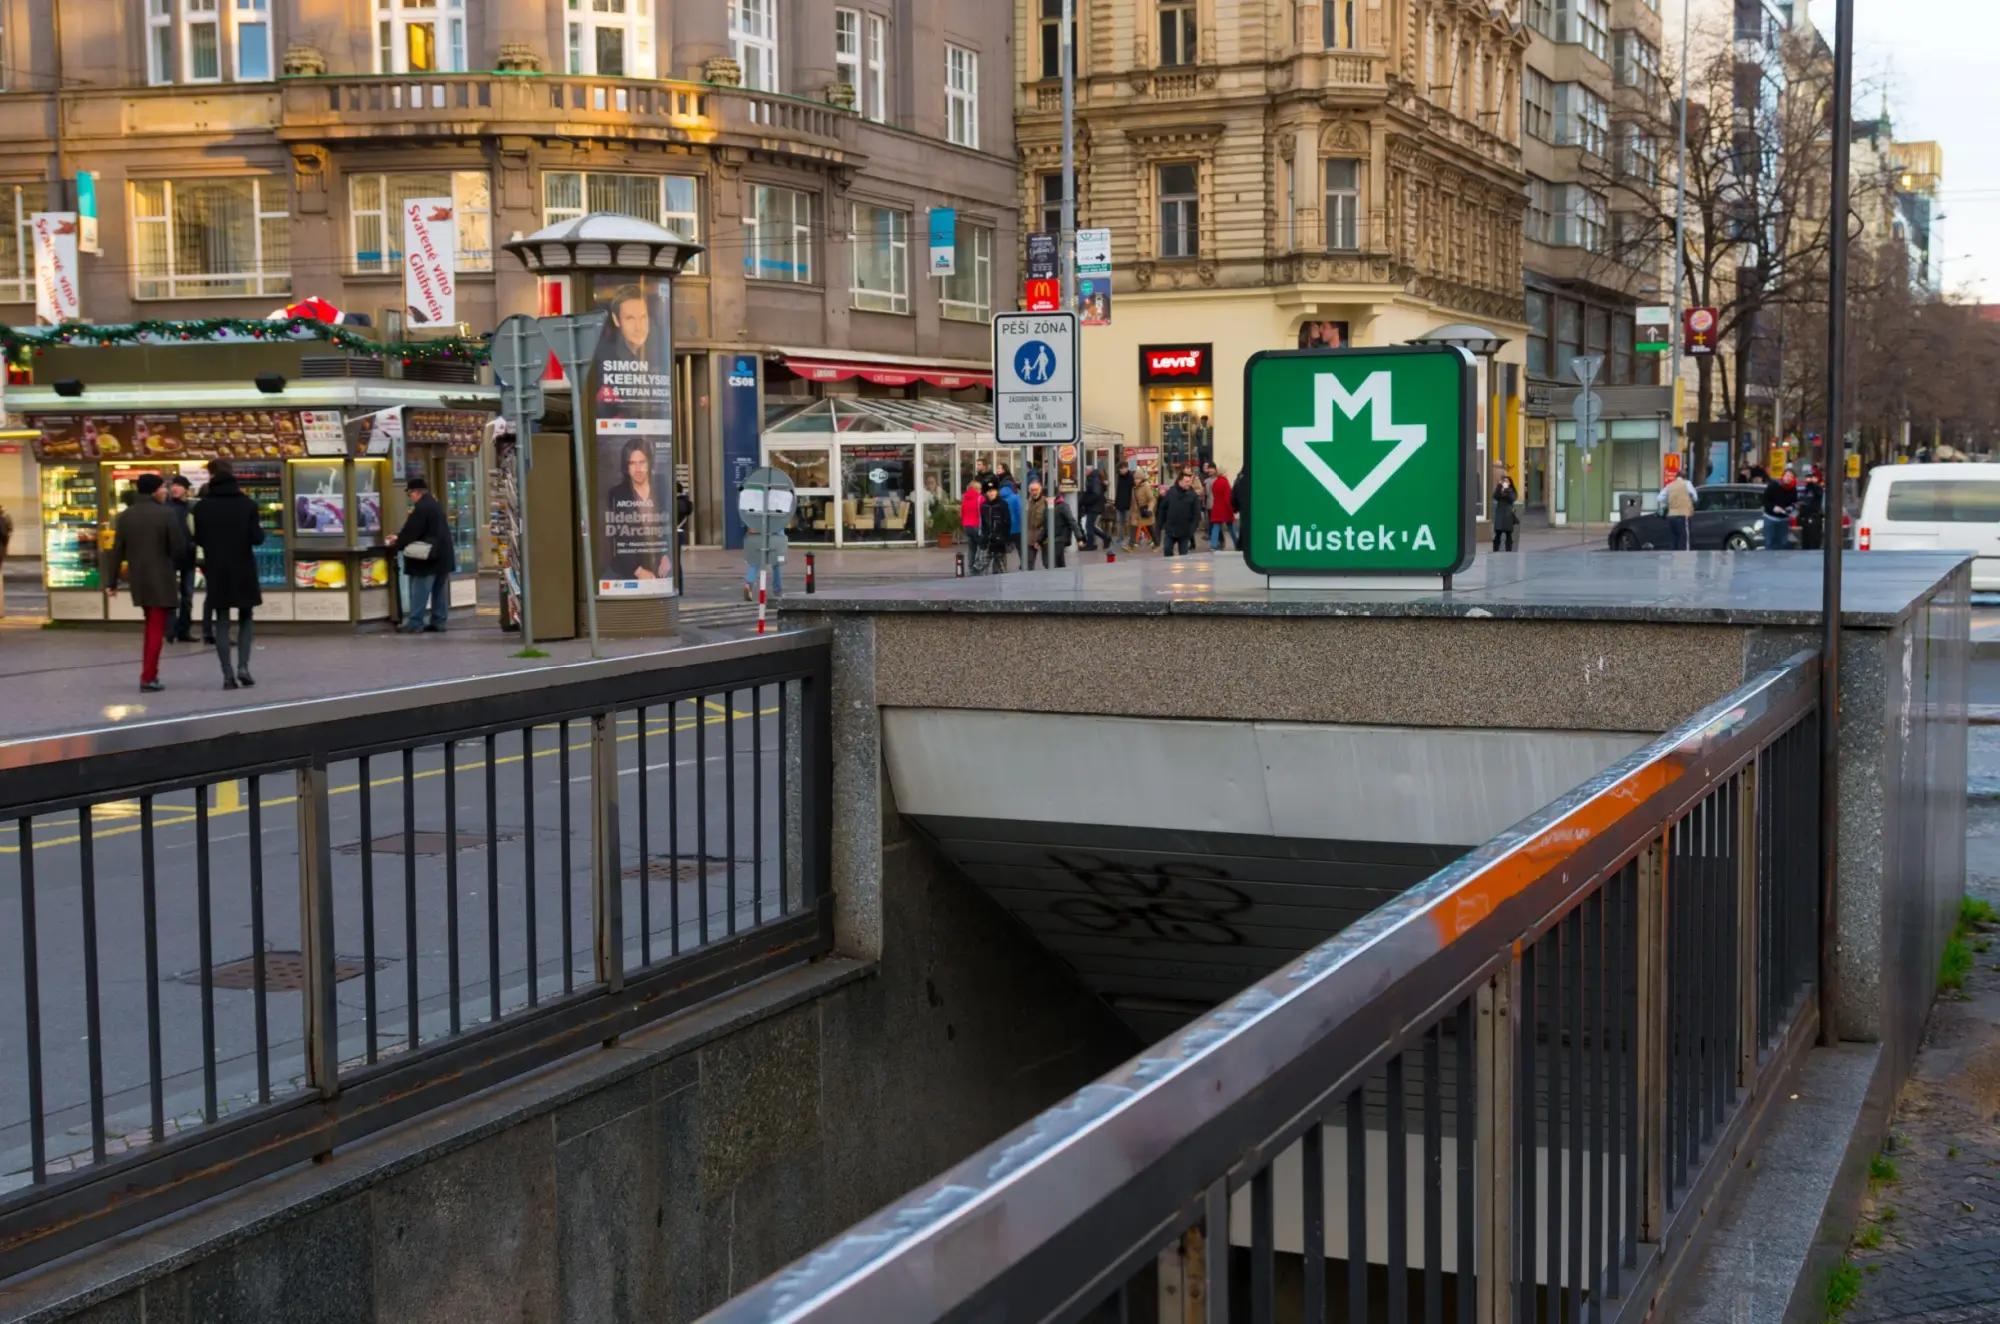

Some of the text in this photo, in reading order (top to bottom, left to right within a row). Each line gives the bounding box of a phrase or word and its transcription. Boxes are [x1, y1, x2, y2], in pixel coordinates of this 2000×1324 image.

[1002, 320, 1067, 334] PĚŠÍ ZÓNA
[603, 360, 649, 372] SIMON
